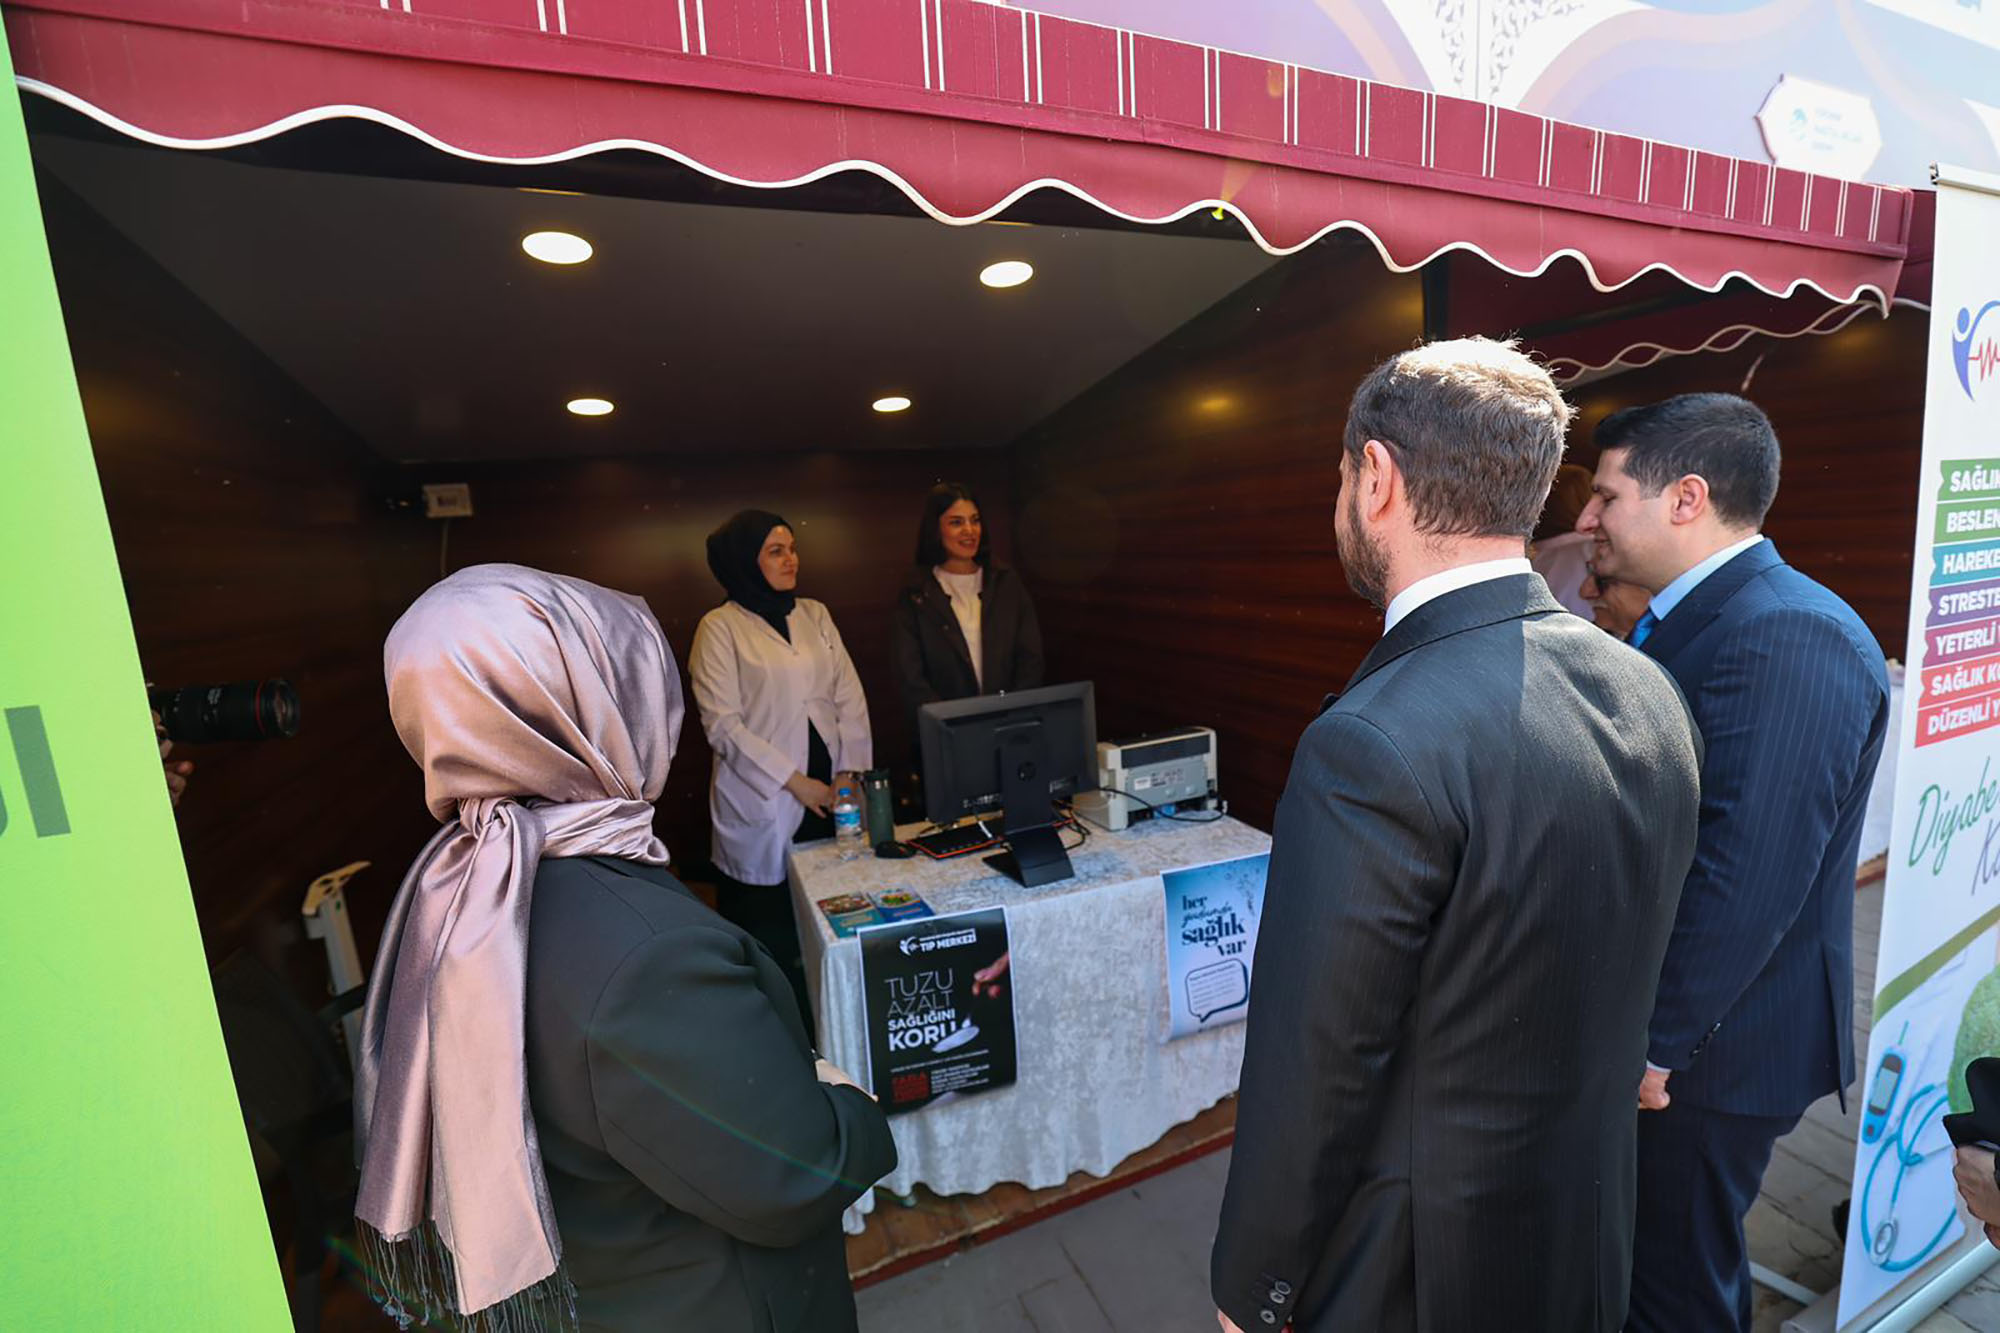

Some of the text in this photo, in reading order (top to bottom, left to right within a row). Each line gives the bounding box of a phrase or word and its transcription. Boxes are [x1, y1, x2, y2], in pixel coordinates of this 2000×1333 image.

[1942, 548, 2000, 575] HAREKE
[1935, 621, 1996, 656] YETERLİ
[1930, 665, 1985, 696] SAĞLIK
[1927, 696, 1991, 736] DÜZENLİ
[1182, 895, 1208, 910] her
[1182, 912, 1245, 948] sağlık
[920, 940, 936, 953] TIP
[1217, 939, 1247, 957] var
[885, 968, 954, 999] TUZU
[887, 990, 954, 1018] AZALT
[888, 1008, 956, 1031] SAĞLIĞINI
